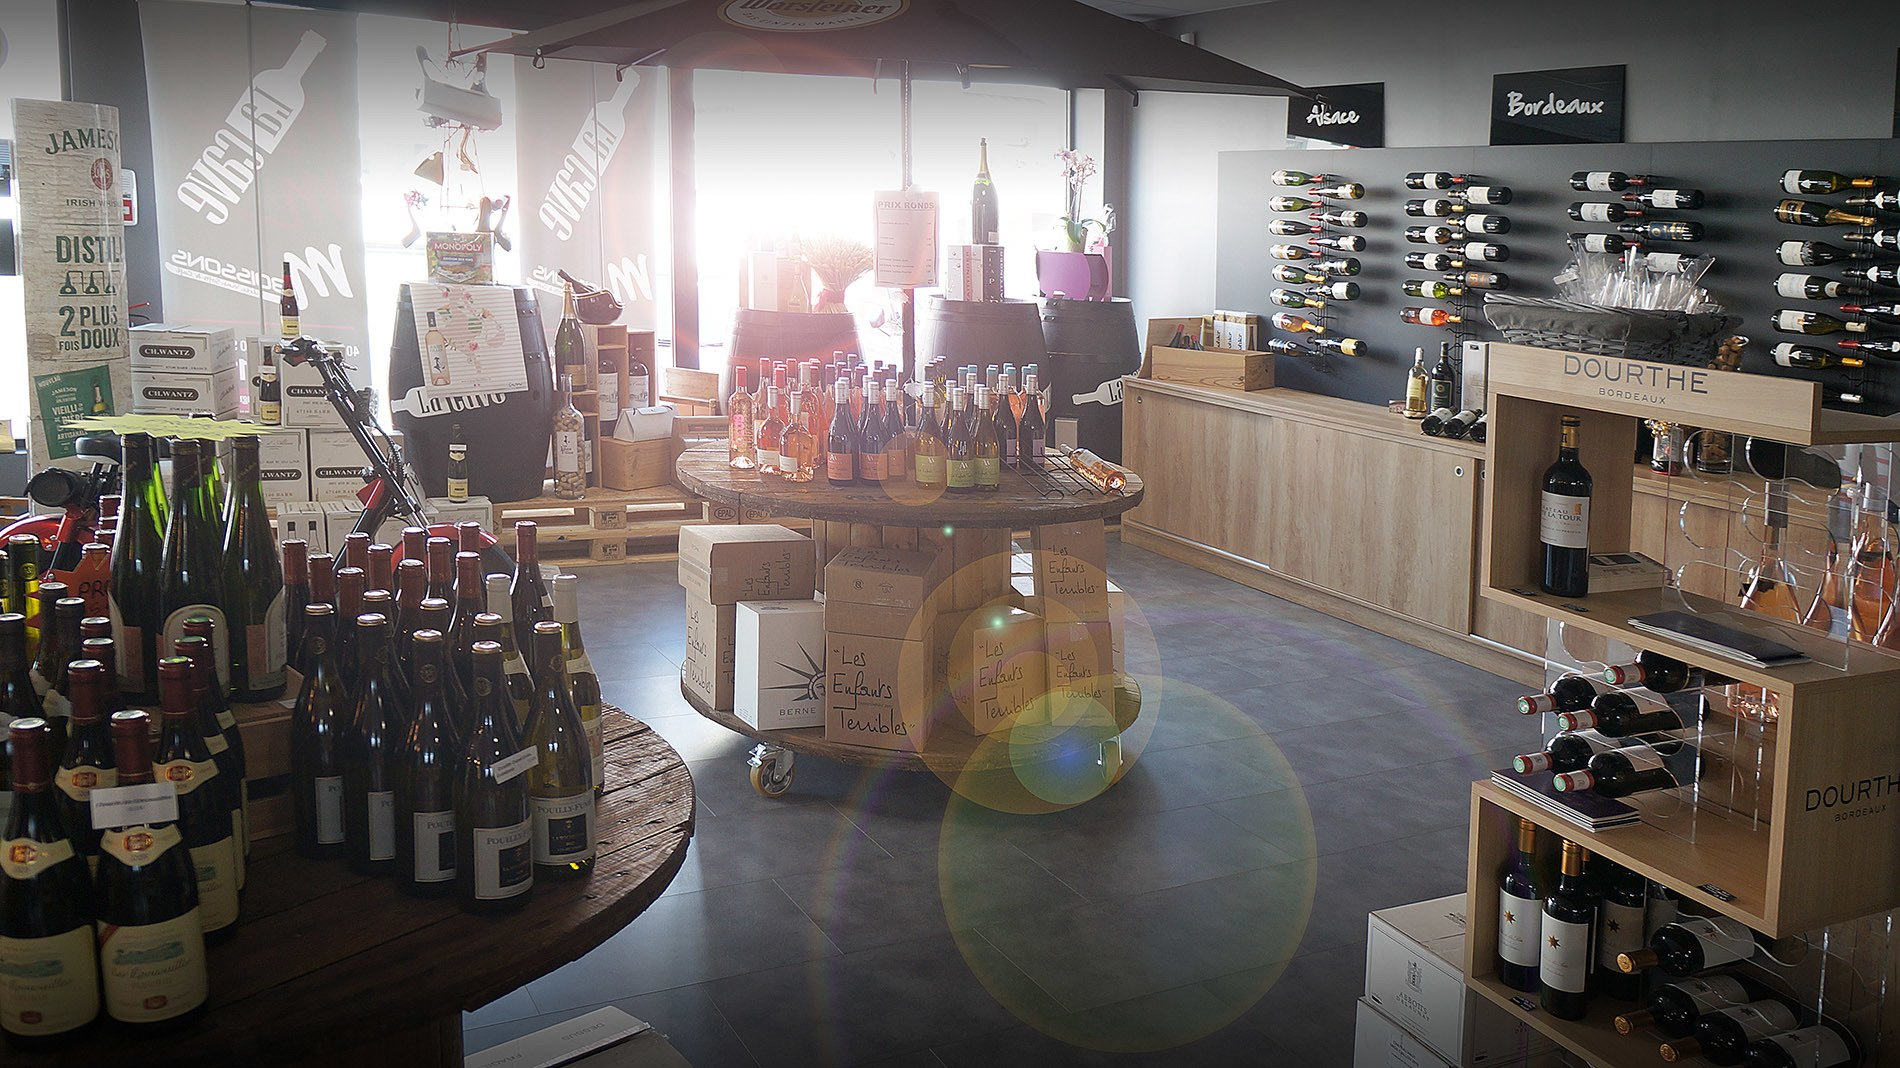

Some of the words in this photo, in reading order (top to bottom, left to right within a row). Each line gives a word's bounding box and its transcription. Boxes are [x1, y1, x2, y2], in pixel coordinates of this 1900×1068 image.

[1507, 90, 1605, 117] Bordeaux
[1306, 104, 1361, 127] Alsace
[66, 198, 96, 207] IRISH
[878, 201, 901, 209] PRIX
[904, 202, 935, 210] RONDS
[433, 242, 482, 252] MONOPOLY
[58, 305, 76, 337] 2
[79, 304, 118, 326] PLUS
[59, 340, 79, 352] FOIS
[80, 328, 120, 350] DOUX
[1564, 354, 1708, 394] DOURTHE
[1599, 387, 1666, 405] BORDEAUX
[716, 508, 733, 519] EPAL
[1558, 514, 1582, 522] TOUR
[1049, 558, 1085, 583] Enfants
[979, 659, 1024, 703] Enfants
[1056, 663, 1093, 687] Enfants
[832, 670, 893, 710] Enfants
[779, 706, 817, 717] BERNE
[1834, 804, 1886, 823] BORDEAUX
[560, 1022, 606, 1042] DESSUS
